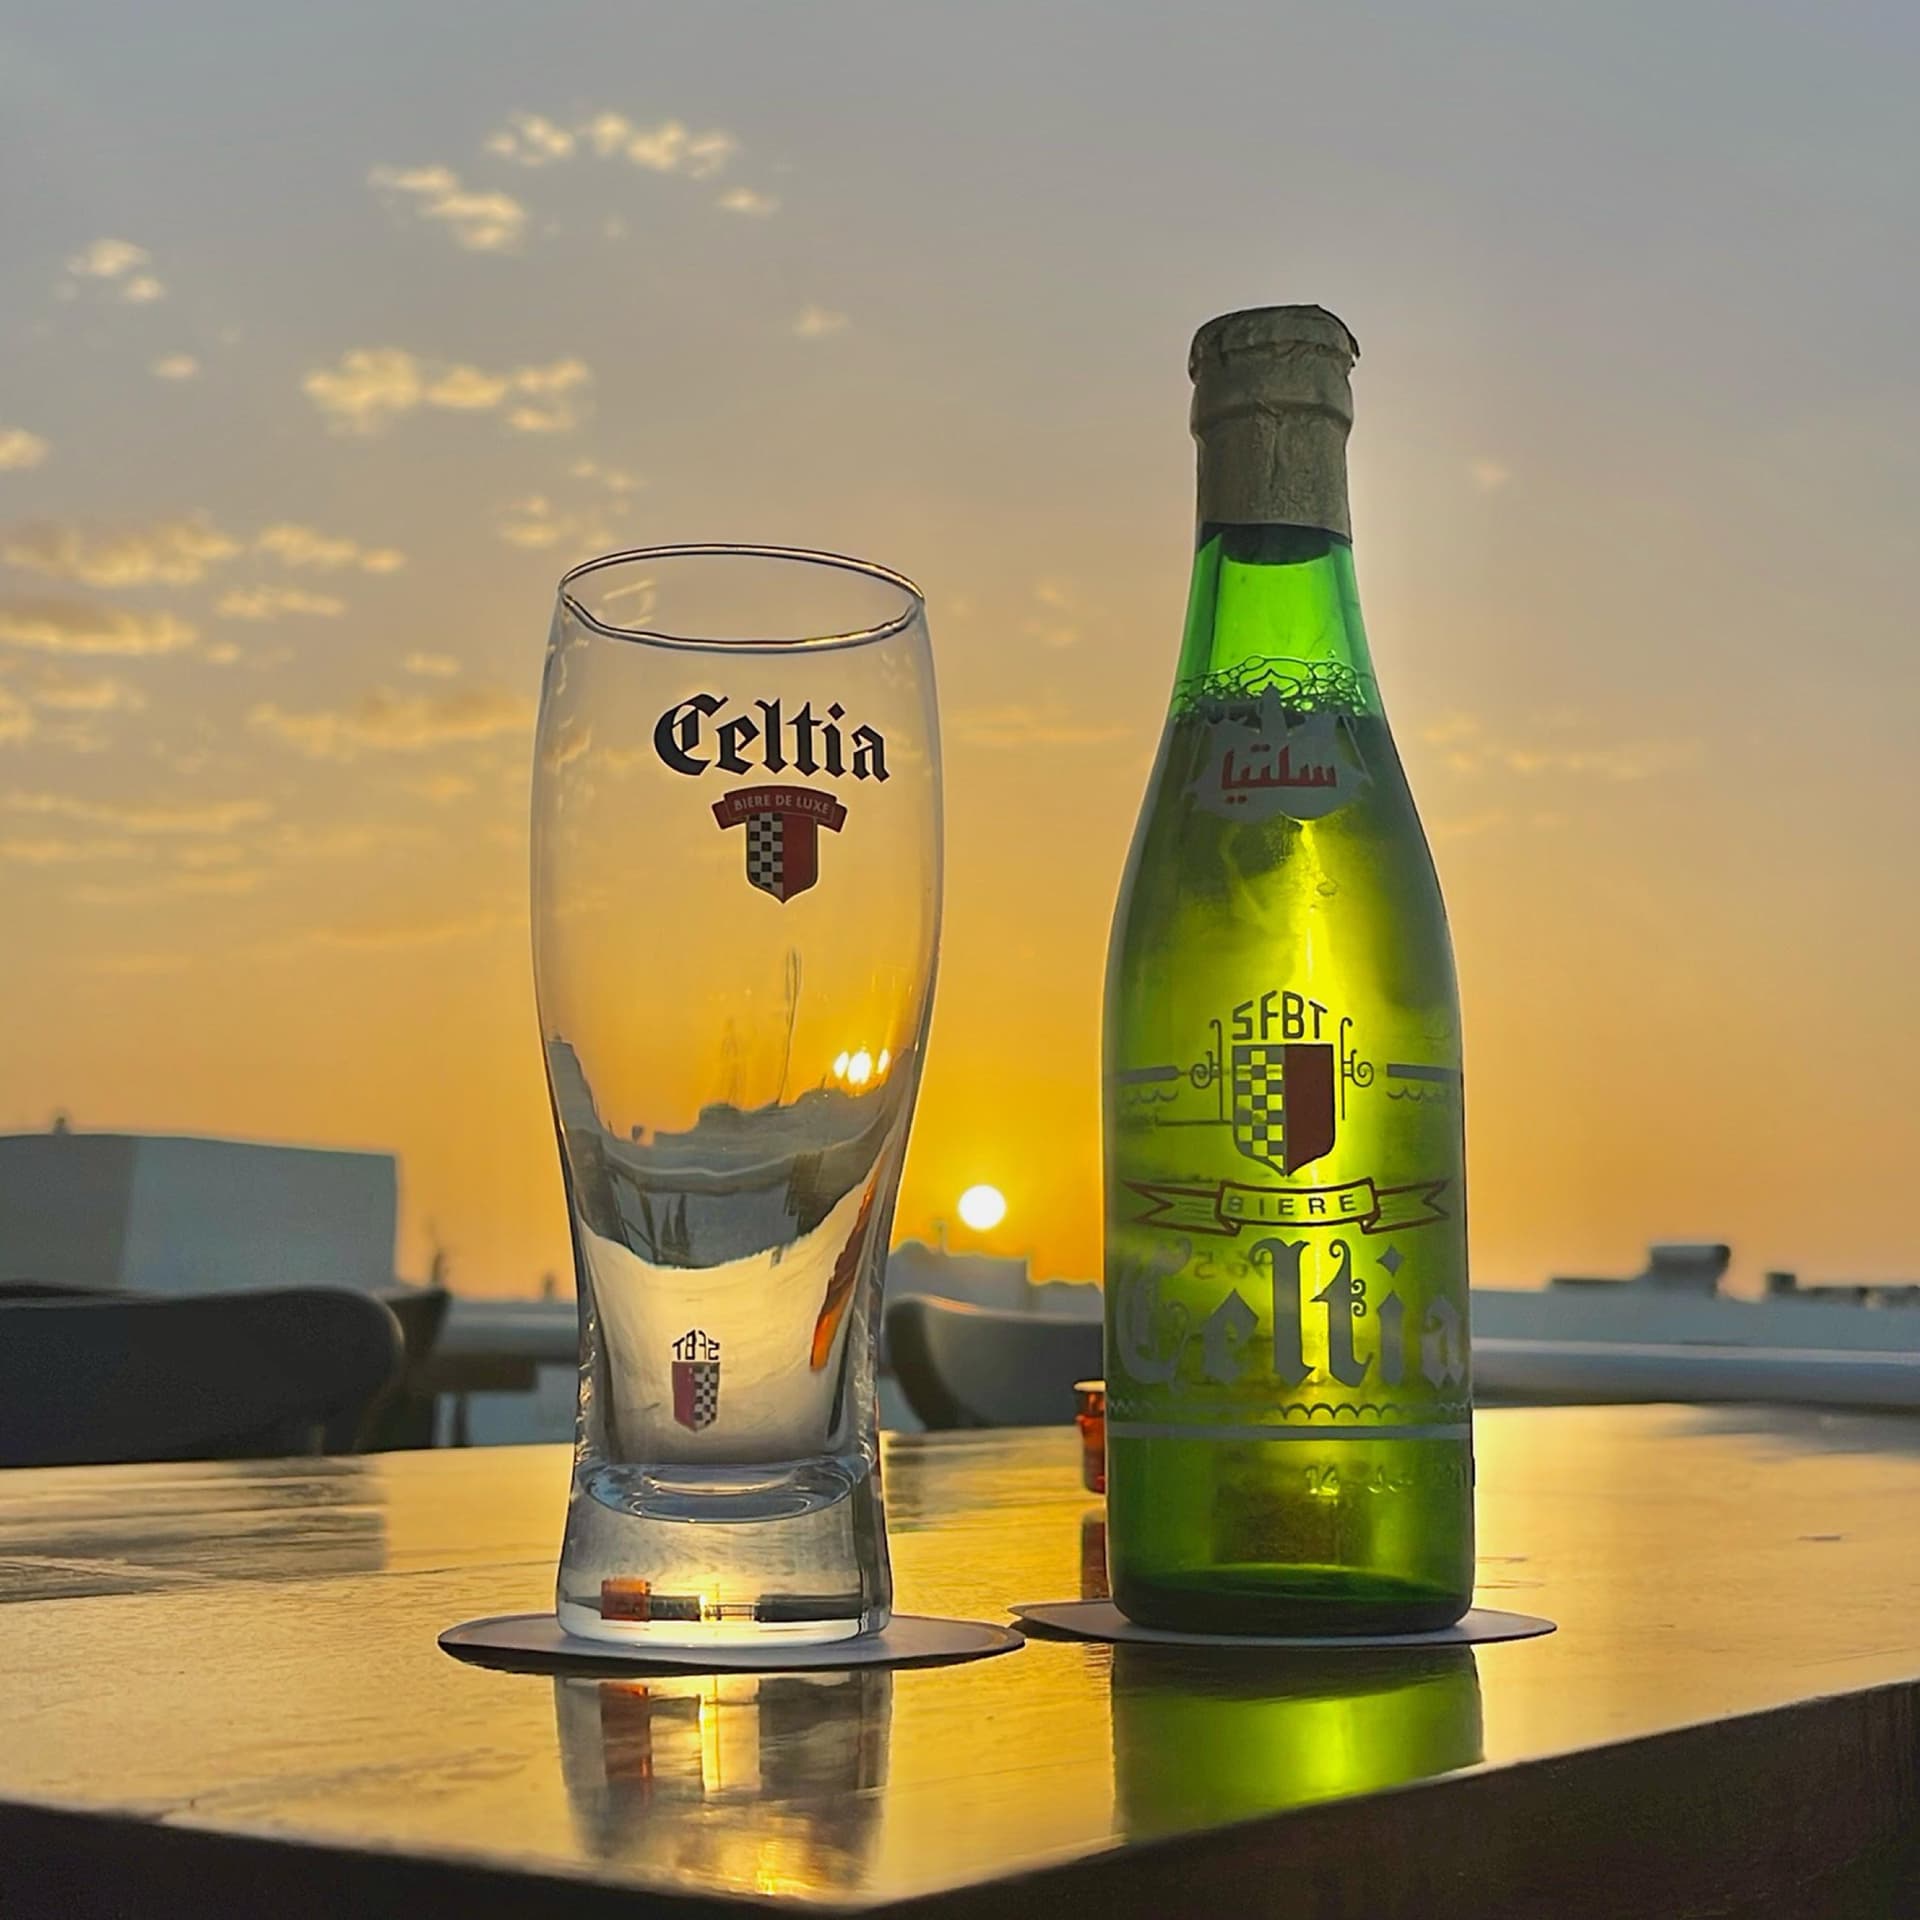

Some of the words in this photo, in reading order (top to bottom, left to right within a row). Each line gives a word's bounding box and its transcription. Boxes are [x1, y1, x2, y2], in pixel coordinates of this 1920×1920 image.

[653, 693, 890, 783] Celtia
[1221, 744, 1338, 805] سلتيا
[733, 793, 771, 812] BIERE
[775, 794, 793, 808] DE
[796, 796, 831, 815] LUXE
[1231, 990, 1329, 1041] SFBT
[1226, 1193, 1358, 1216] BIERE
[1116, 1237, 1466, 1391] Celtia
